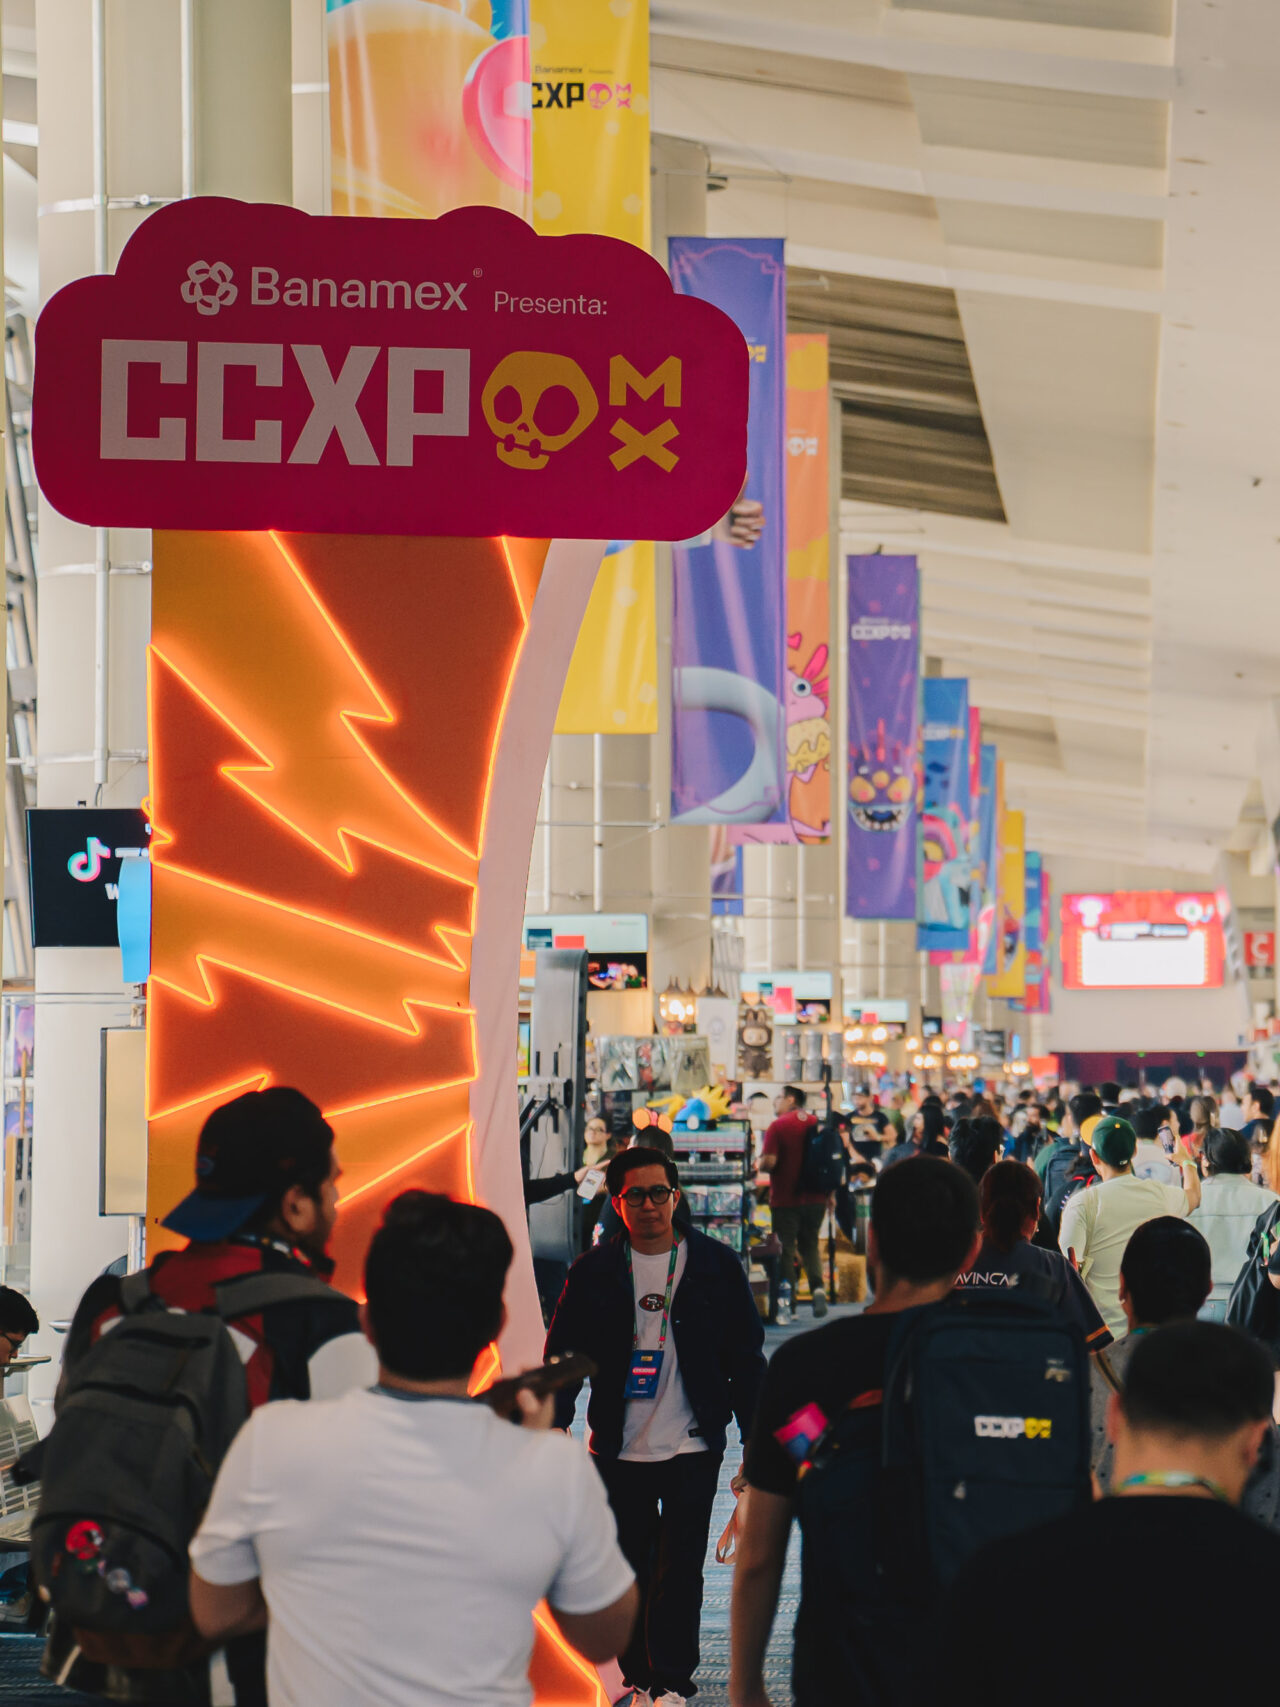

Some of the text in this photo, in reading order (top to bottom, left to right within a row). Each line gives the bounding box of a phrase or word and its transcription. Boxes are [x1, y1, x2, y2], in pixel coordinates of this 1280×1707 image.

[532, 83, 584, 108] CXP
[250, 266, 608, 315] Banamex Presenta:
[100, 338, 471, 467] CCXP
[1251, 934, 1268, 959] C
